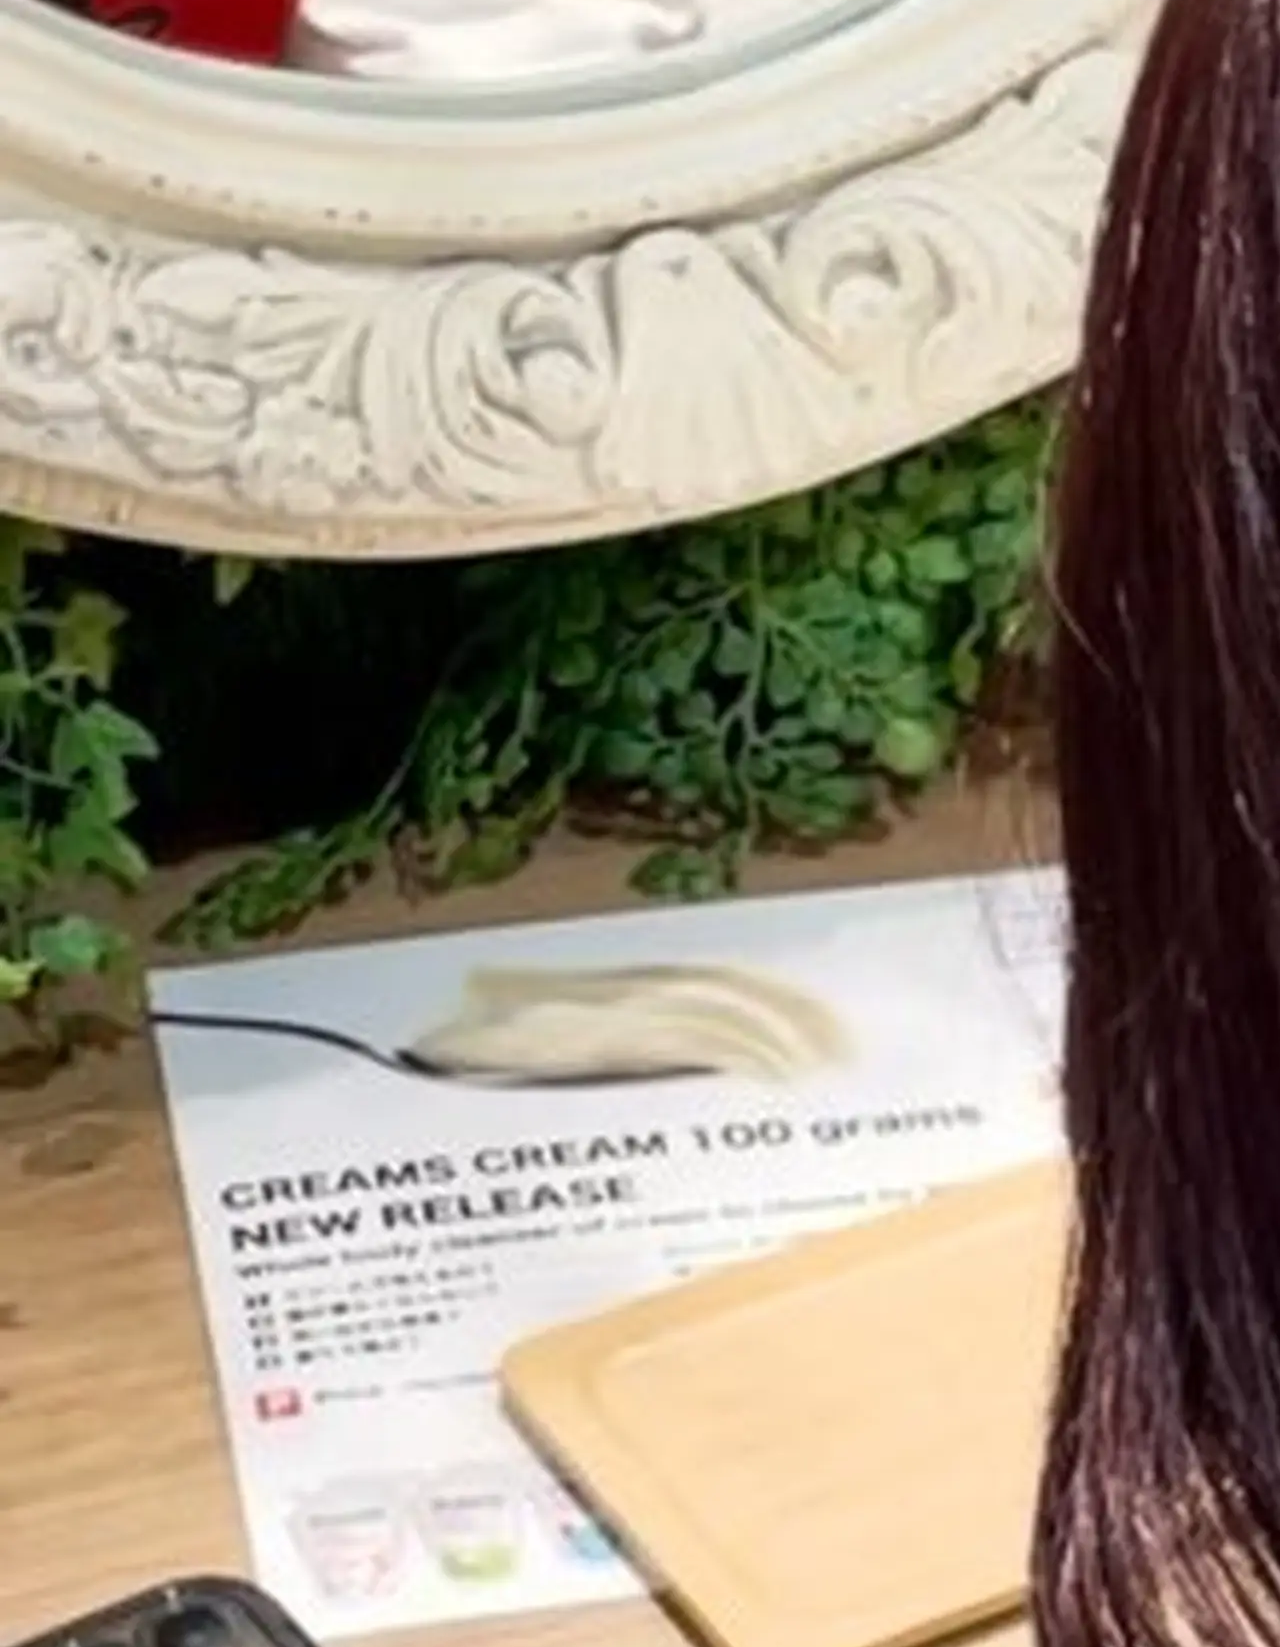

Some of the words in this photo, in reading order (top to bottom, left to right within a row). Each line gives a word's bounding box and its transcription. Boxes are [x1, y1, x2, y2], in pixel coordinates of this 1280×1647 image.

[220, 1154, 458, 1210] CREAMS
[472, 1131, 668, 1175] CREAM
[690, 1119, 793, 1154] 100
[809, 1104, 983, 1146] grams
[230, 1208, 361, 1252] NEW
[381, 1175, 634, 1230] RELEASE
